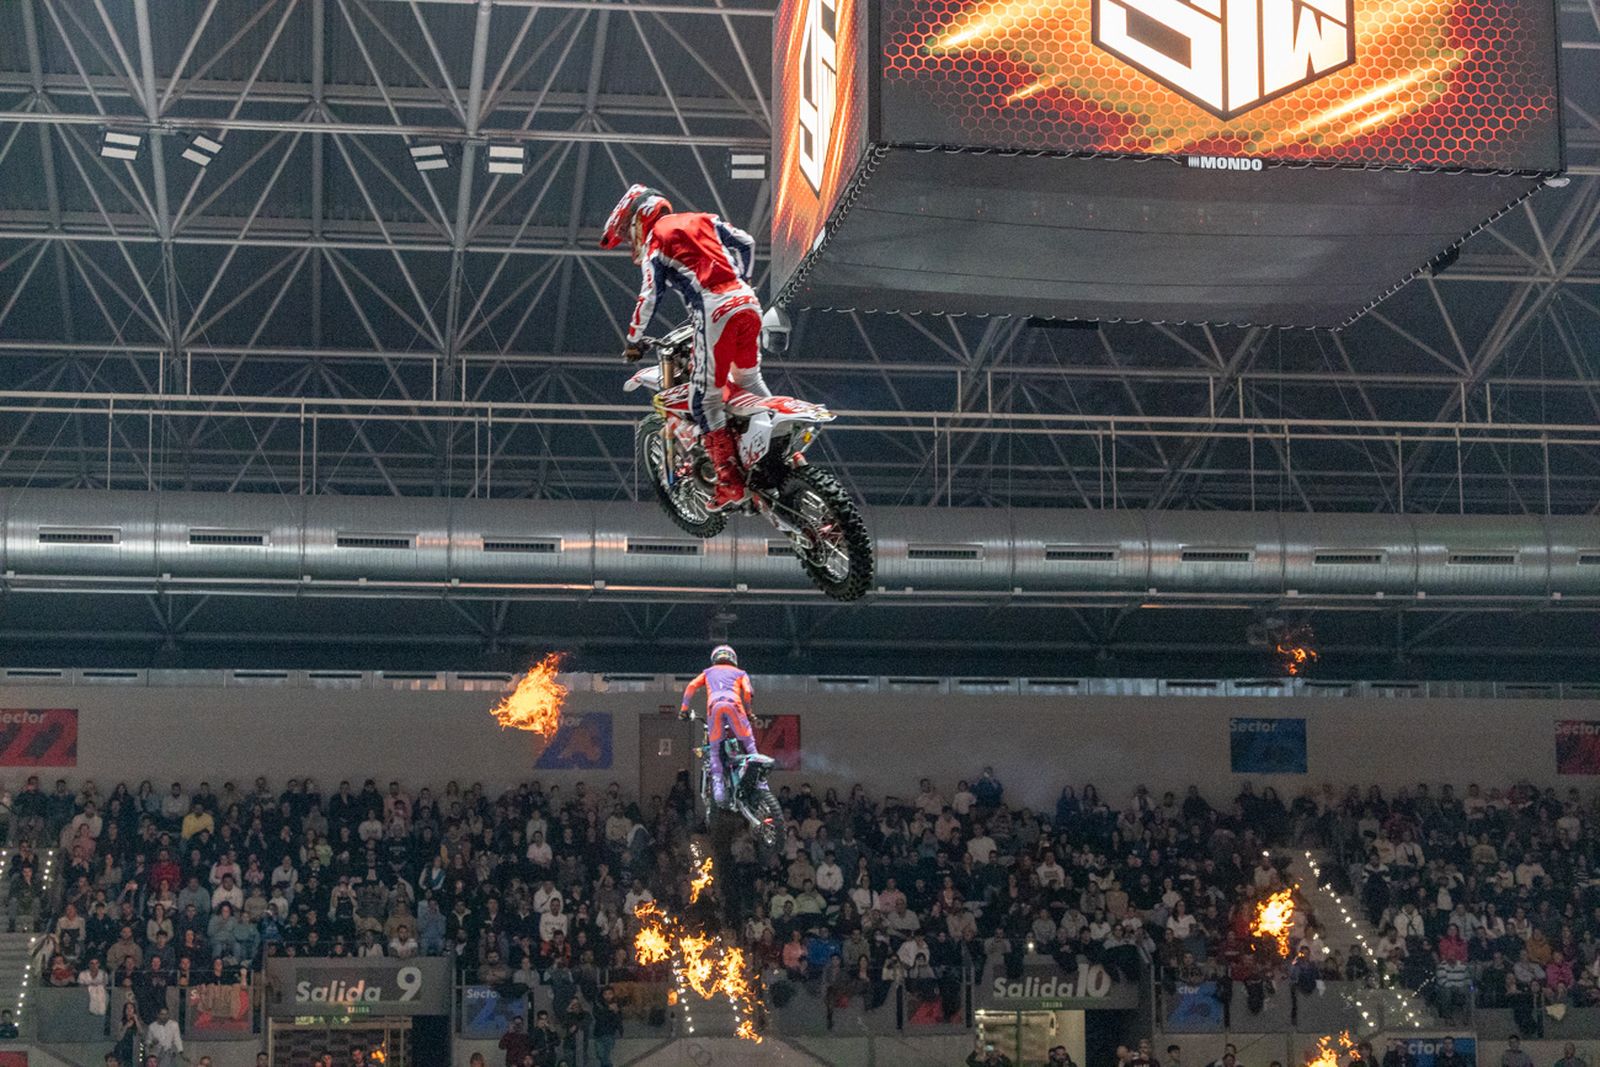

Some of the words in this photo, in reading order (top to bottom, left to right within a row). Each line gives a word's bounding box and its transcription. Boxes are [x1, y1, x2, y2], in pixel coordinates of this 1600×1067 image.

[1200, 156, 1263, 171] MONDO
[1231, 719, 1279, 732] Sector
[296, 980, 381, 1002] Salida
[397, 967, 422, 1001] 9
[993, 976, 1073, 998] Salida
[1077, 963, 1111, 998] 10
[466, 988, 498, 999] Secto
[1407, 1040, 1443, 1056] ctor
